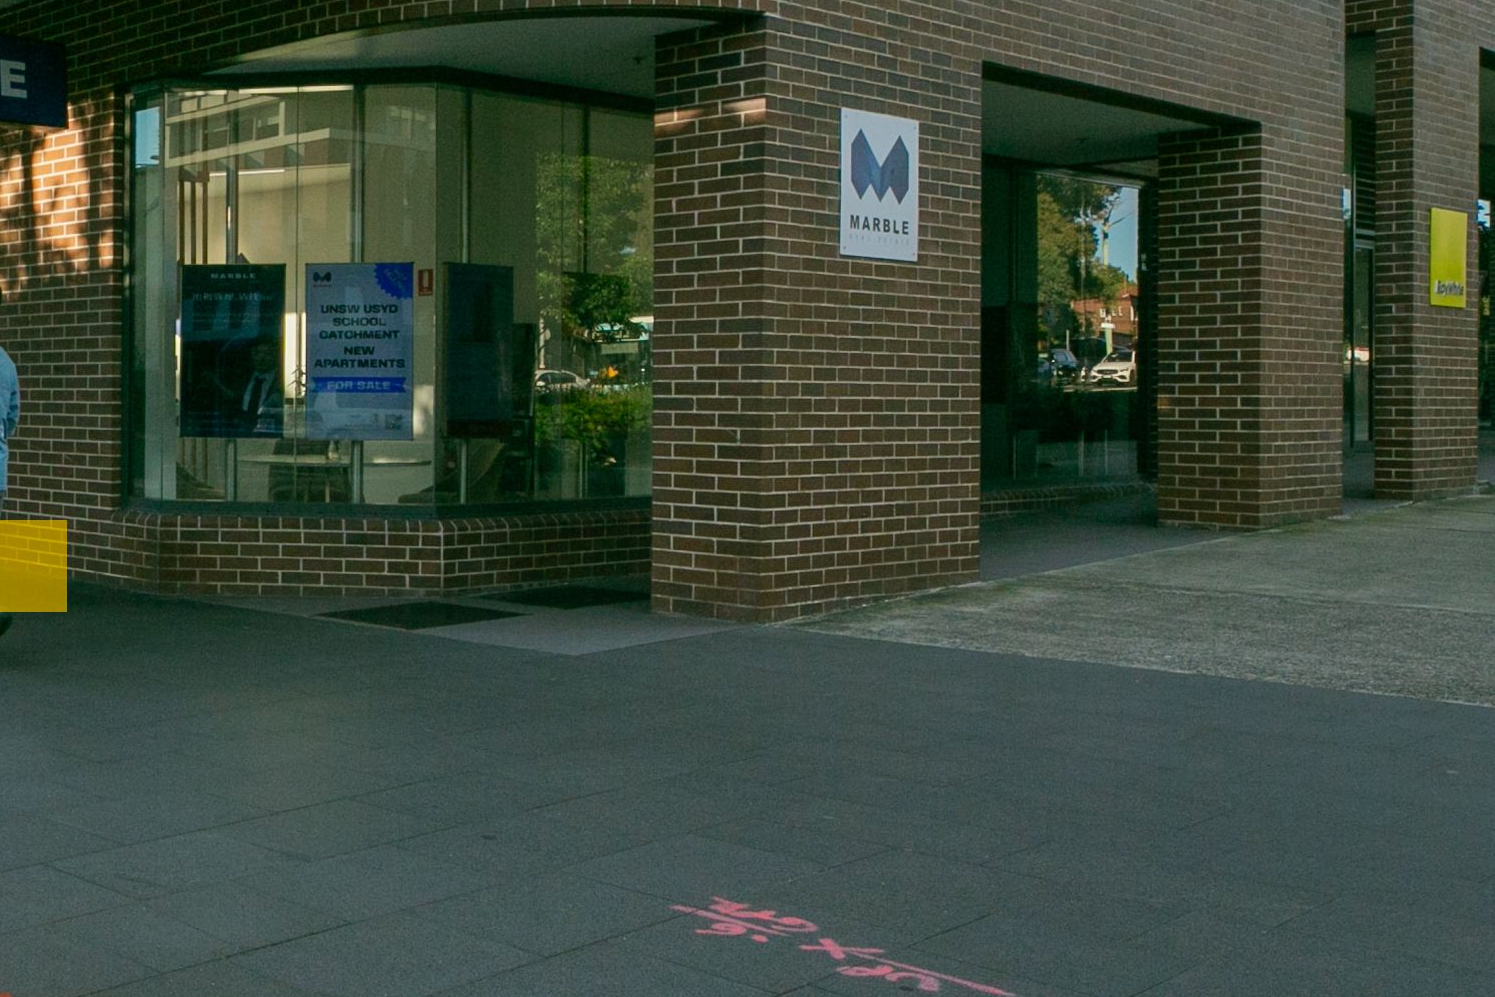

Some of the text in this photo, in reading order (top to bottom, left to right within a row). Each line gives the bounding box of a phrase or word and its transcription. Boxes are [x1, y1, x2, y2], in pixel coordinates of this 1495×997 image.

[850, 214, 909, 235] MARBLE
[320, 304, 399, 314] UNSW USYD
[332, 317, 387, 326] SCHOOL
[318, 330, 400, 340] CATCHMENT
[343, 346, 375, 355] NEW
[313, 358, 406, 369] APARTMENTS
[326, 381, 391, 390] FOR SALE
